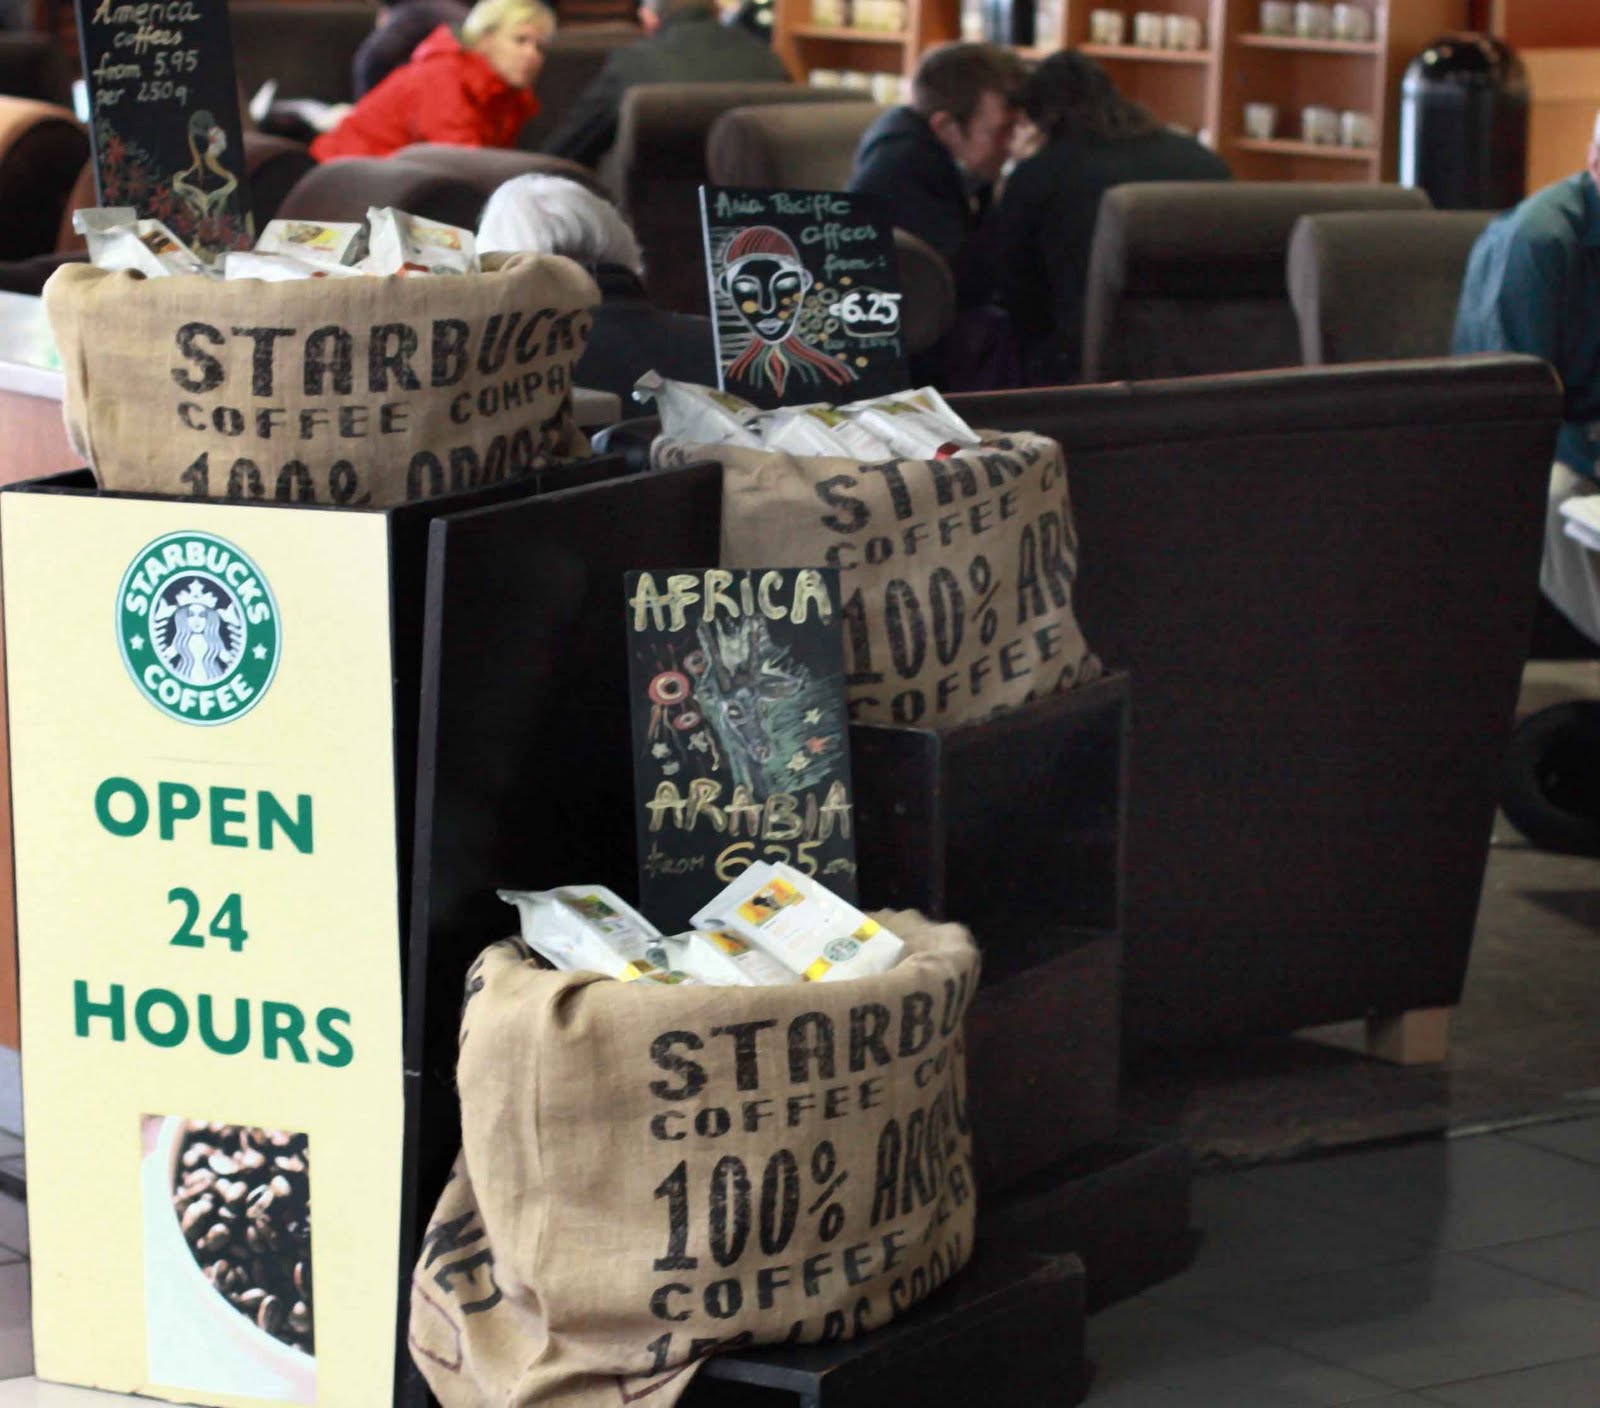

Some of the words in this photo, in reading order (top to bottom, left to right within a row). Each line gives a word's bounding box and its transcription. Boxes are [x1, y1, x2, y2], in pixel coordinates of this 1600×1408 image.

[91, 0, 202, 25] America
[113, 24, 183, 55] coffees
[92, 52, 141, 84] from
[153, 49, 199, 77] 5.95
[769, 192, 852, 221] Pacific
[177, 402, 408, 439] COFFEE
[450, 361, 574, 425] COMPA
[825, 492, 1018, 570] COFFEE
[126, 541, 270, 625] STARBUCKS
[629, 569, 833, 632] AFRICA
[842, 555, 1001, 685] 100%
[144, 664, 254, 716] COFFEE
[94, 776, 314, 854] OPEN
[646, 779, 853, 841] ARABIA
[168, 887, 248, 952] 24
[73, 979, 354, 1068] HOURS
[650, 1076, 884, 1141] COFFEE
[654, 1140, 848, 1272] 100%
[649, 1230, 905, 1322] COFFEE
